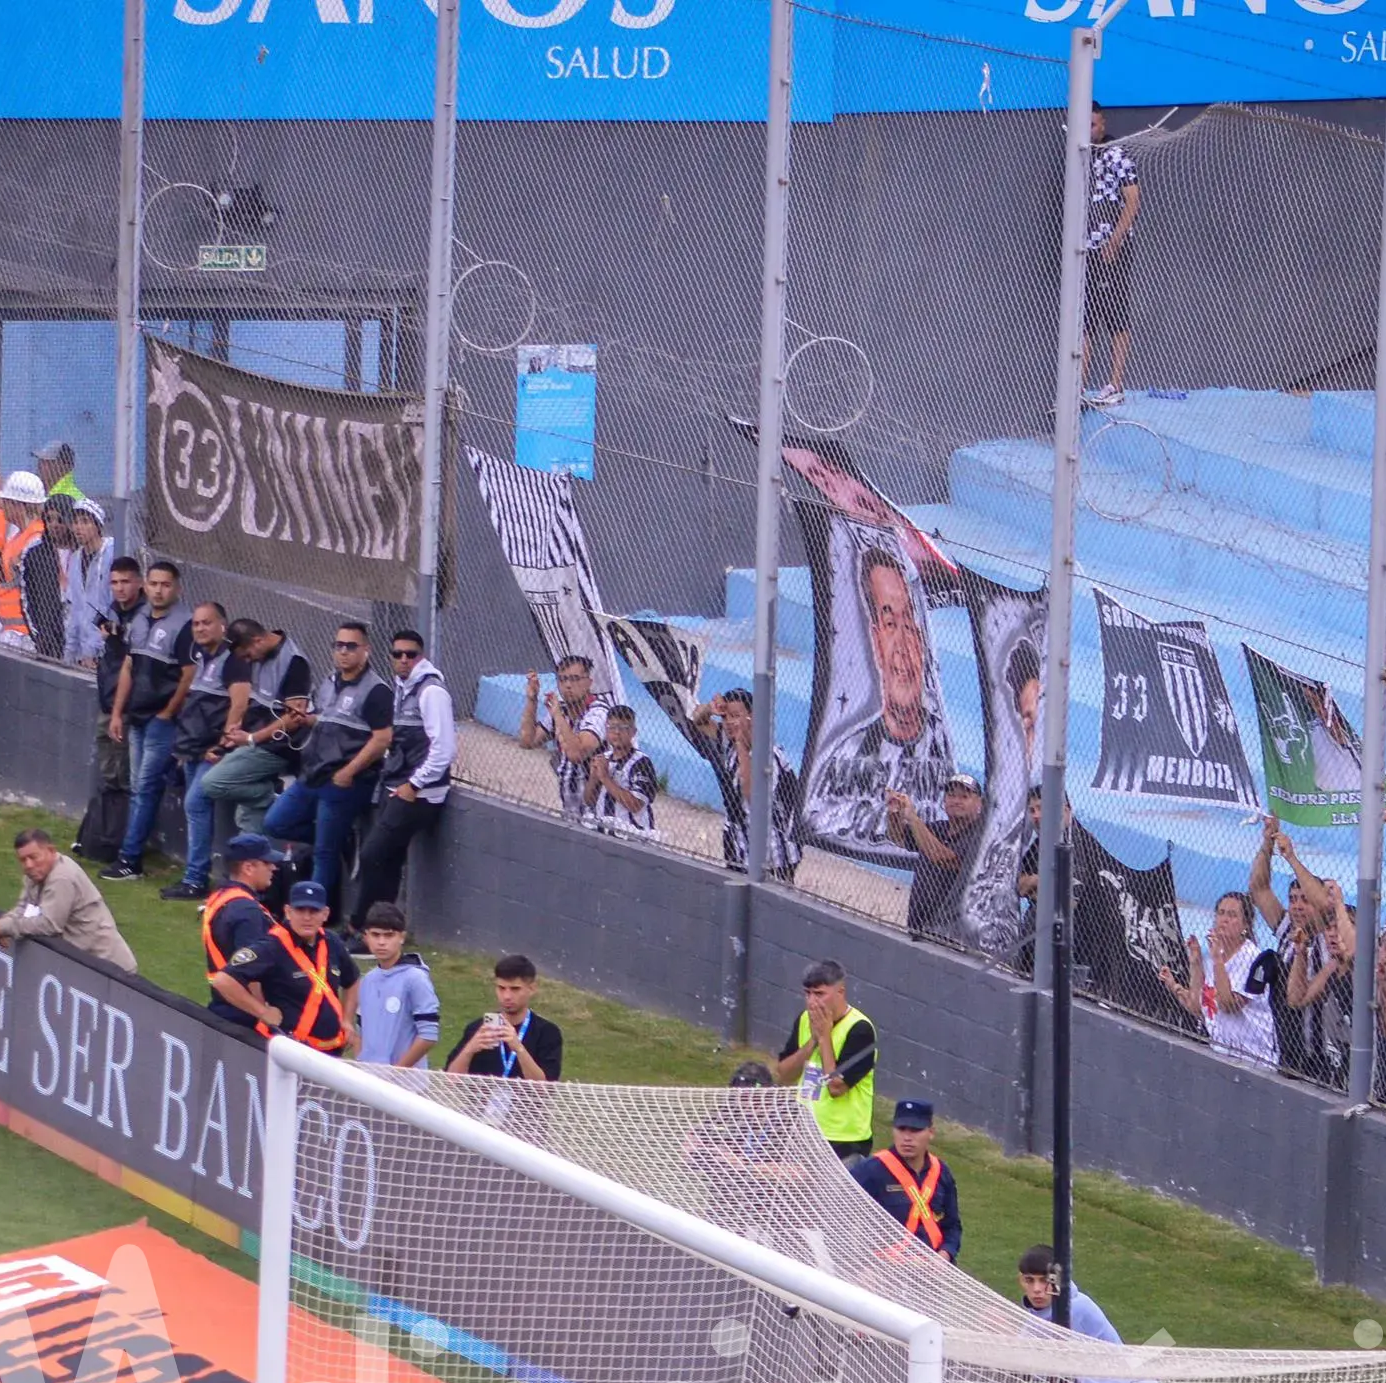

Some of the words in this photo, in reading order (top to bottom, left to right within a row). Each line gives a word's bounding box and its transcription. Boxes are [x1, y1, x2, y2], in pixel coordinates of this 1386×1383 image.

[546, 46, 670, 79] SALUD
[172, 419, 222, 498] 33
[1112, 672, 1148, 722] 33
[1146, 755, 1235, 791] MENDOZA
[1270, 786, 1329, 805] SIEMPRE
[31, 974, 134, 1139] SER
